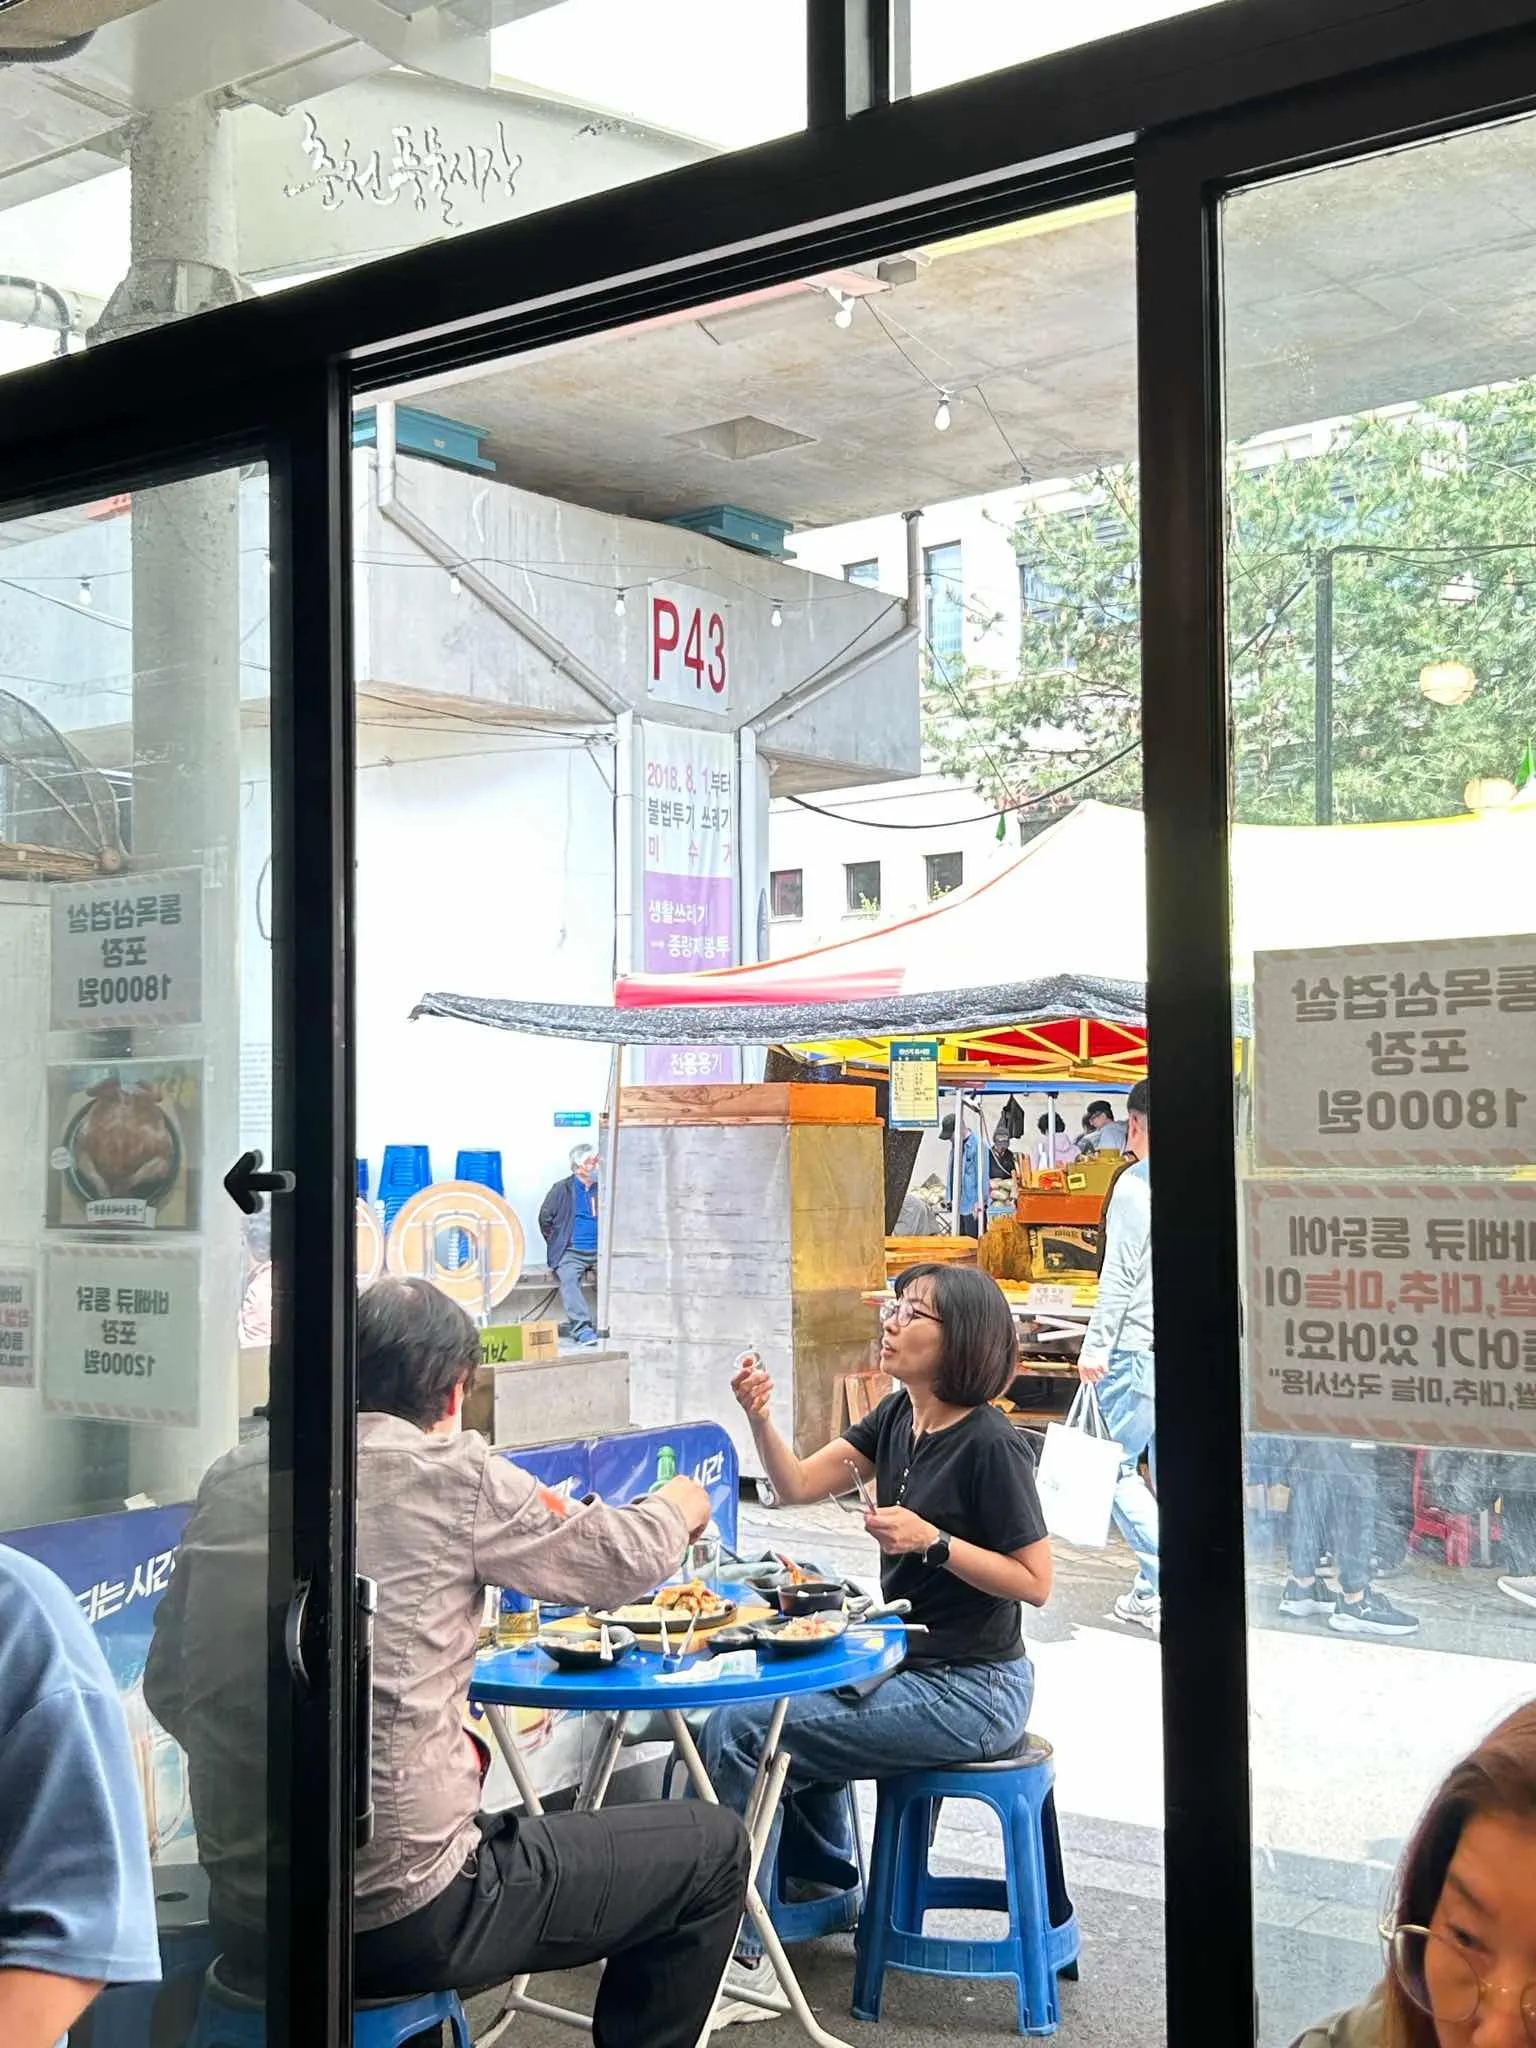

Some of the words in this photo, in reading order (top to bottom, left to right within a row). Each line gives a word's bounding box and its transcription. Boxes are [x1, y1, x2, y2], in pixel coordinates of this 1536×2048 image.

[653, 597, 727, 693] P43
[648, 797, 695, 831] 불법투기
[701, 806, 732, 832] 쓰레기
[649, 900, 708, 926] 생활쓰레기
